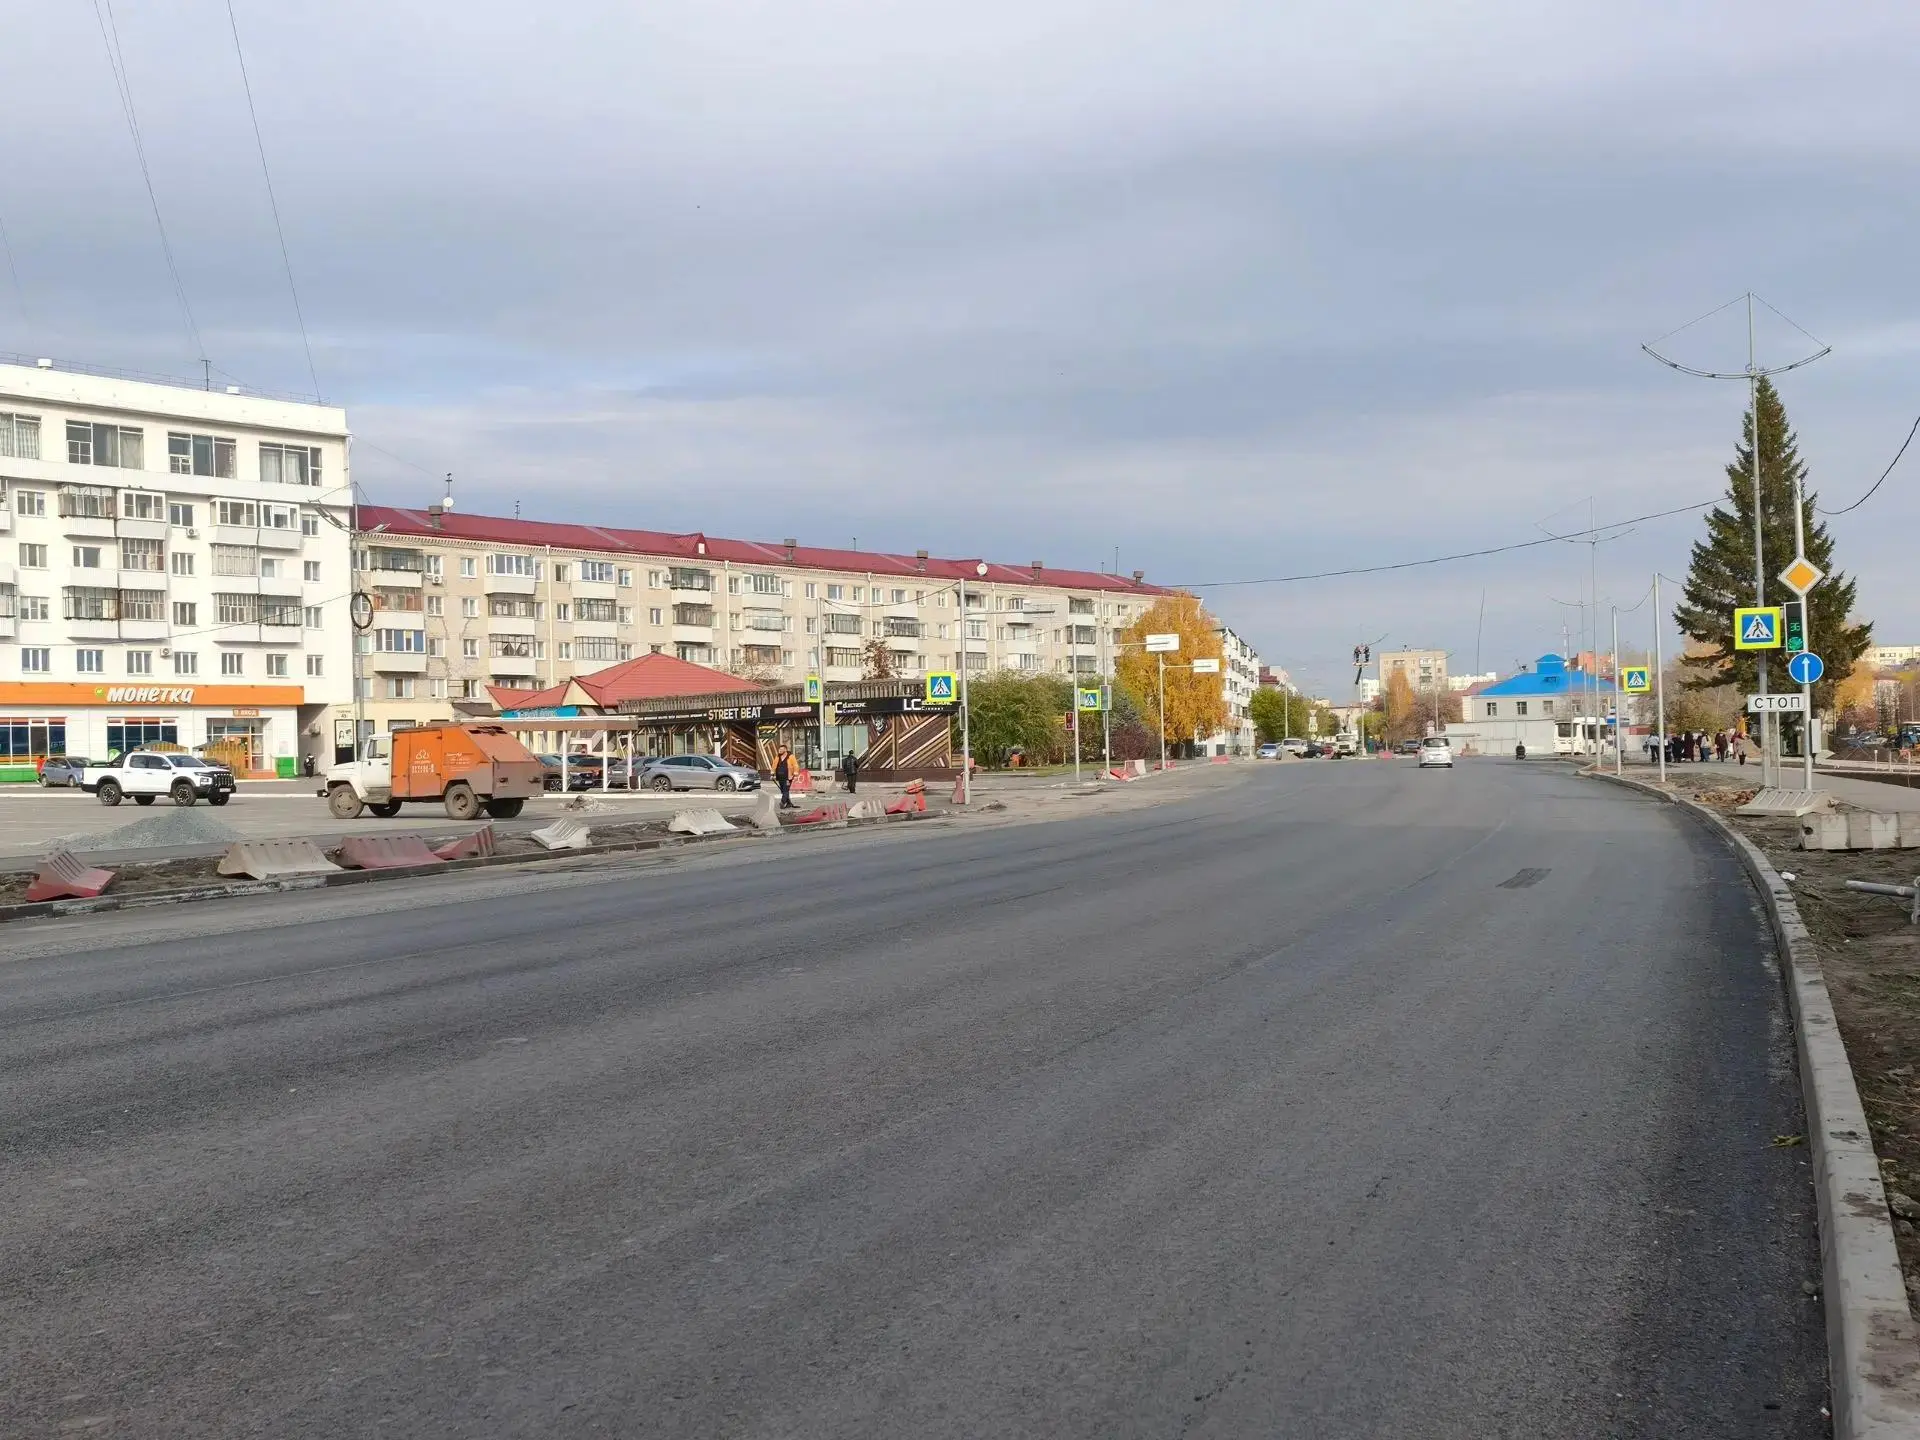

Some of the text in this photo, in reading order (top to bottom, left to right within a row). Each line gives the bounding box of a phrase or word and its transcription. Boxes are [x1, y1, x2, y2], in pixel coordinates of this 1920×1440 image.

[903, 699, 921, 711] LC
[1754, 696, 1800, 709] СТОП
[708, 708, 739, 720] STREET
[740, 706, 762, 719] BEAT
